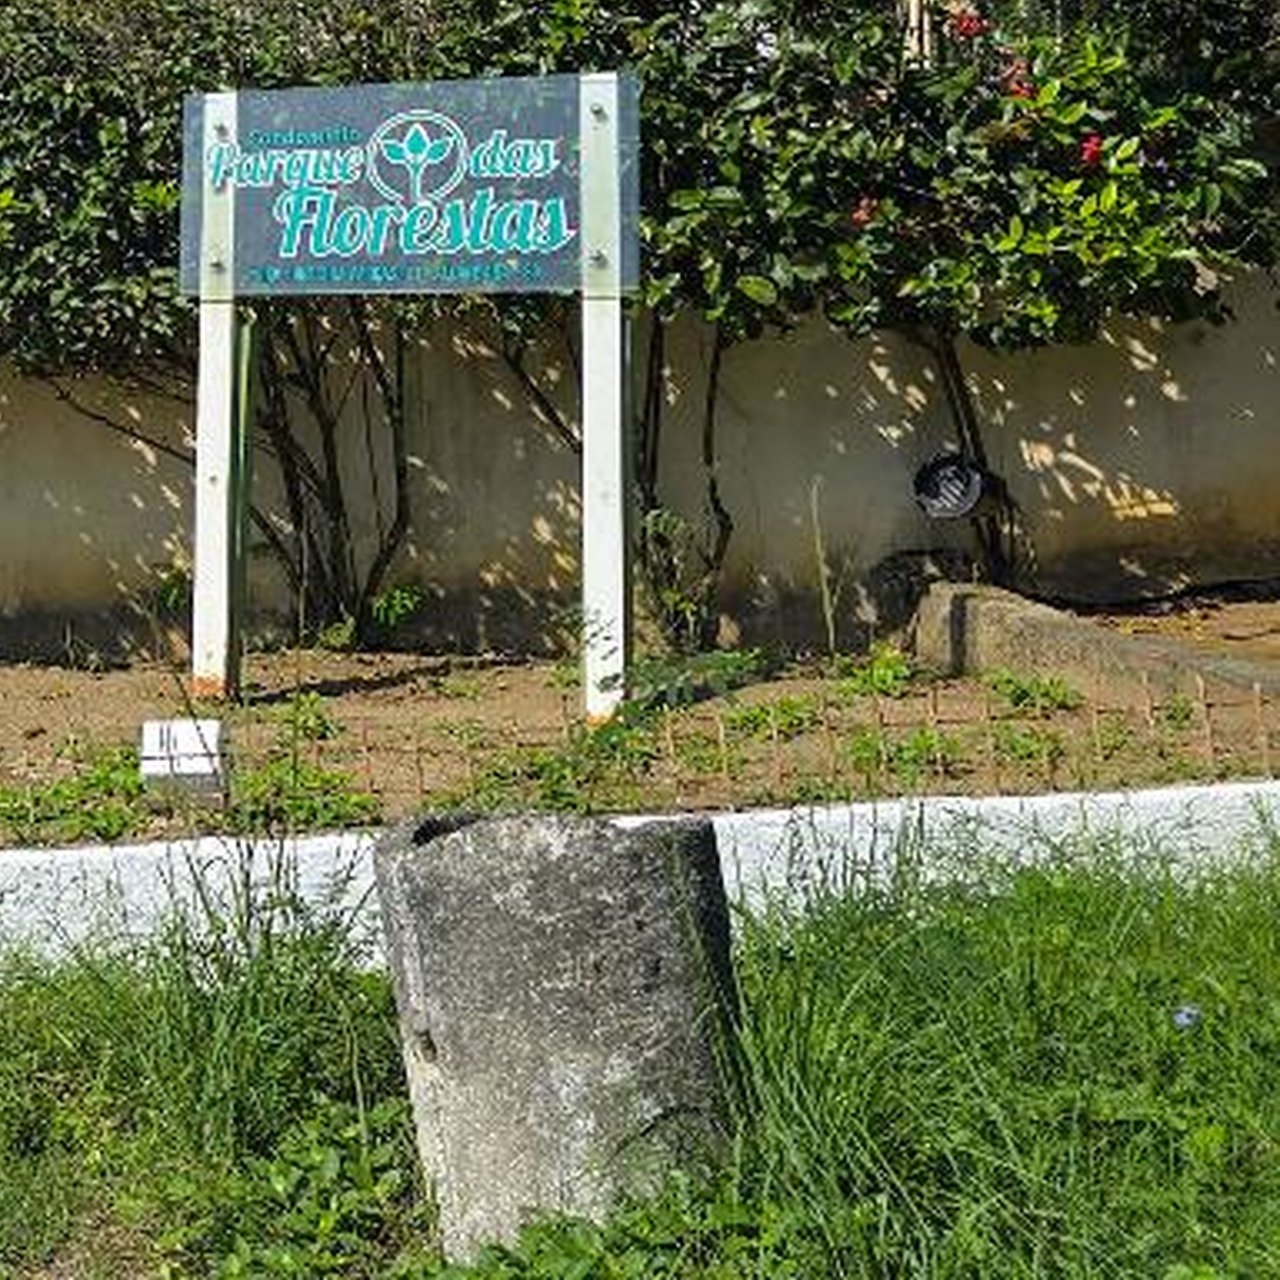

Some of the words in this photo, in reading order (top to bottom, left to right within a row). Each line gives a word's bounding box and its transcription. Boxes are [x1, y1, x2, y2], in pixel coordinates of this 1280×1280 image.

[210, 142, 365, 187] Parque
[471, 130, 560, 177] das
[273, 186, 575, 258] Florestas
